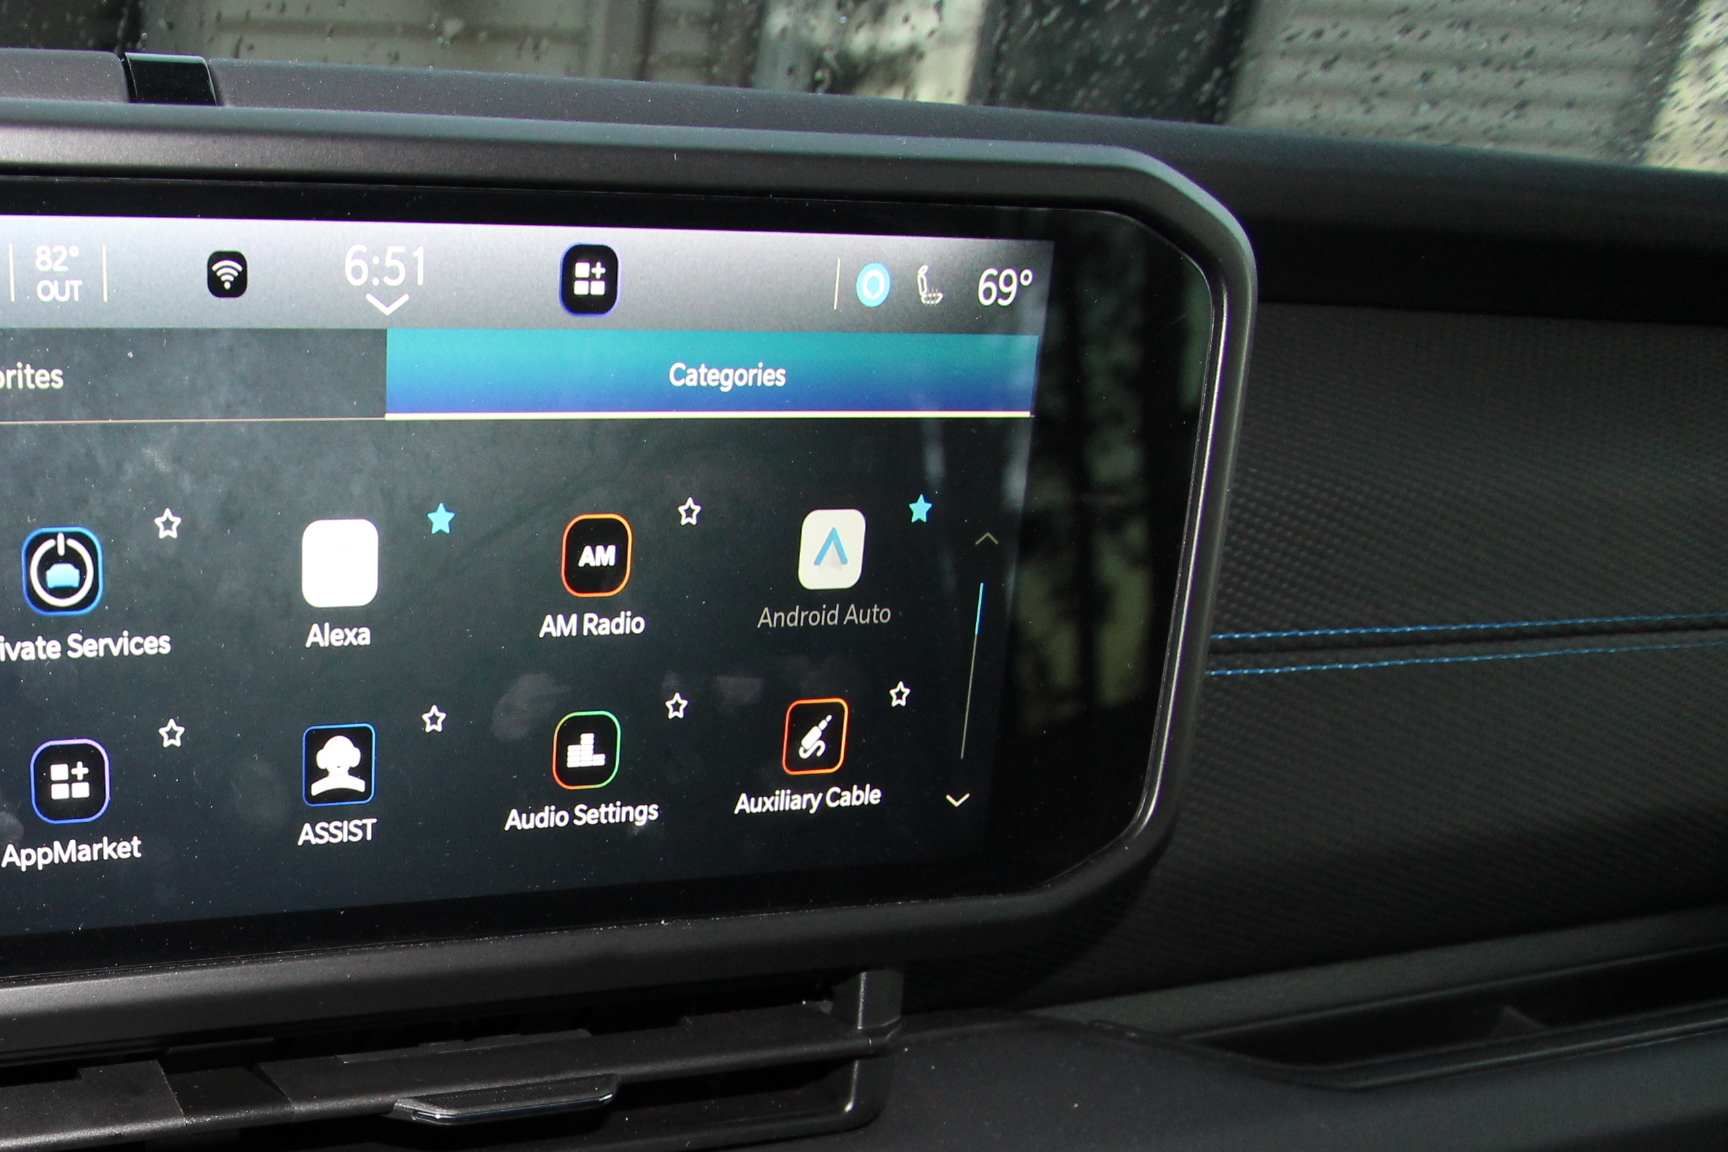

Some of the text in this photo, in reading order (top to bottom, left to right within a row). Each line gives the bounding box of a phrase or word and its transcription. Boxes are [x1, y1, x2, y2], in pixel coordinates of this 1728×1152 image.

[35, 245, 80, 272] 82°
[344, 244, 425, 287] 6:51
[36, 279, 83, 303] OUT
[977, 268, 1034, 307] 69°
[669, 362, 787, 392] Categories
[578, 545, 616, 568] AM
[539, 611, 646, 638] AM Radio
[757, 604, 891, 630] Android Auto
[66, 630, 172, 659] Services
[305, 622, 371, 648] Alexa
[734, 784, 882, 815] Auxiliary Cable
[504, 800, 659, 832] Audio Settings
[297, 817, 377, 847] ASSIST
[1, 835, 142, 872] AppMarket
